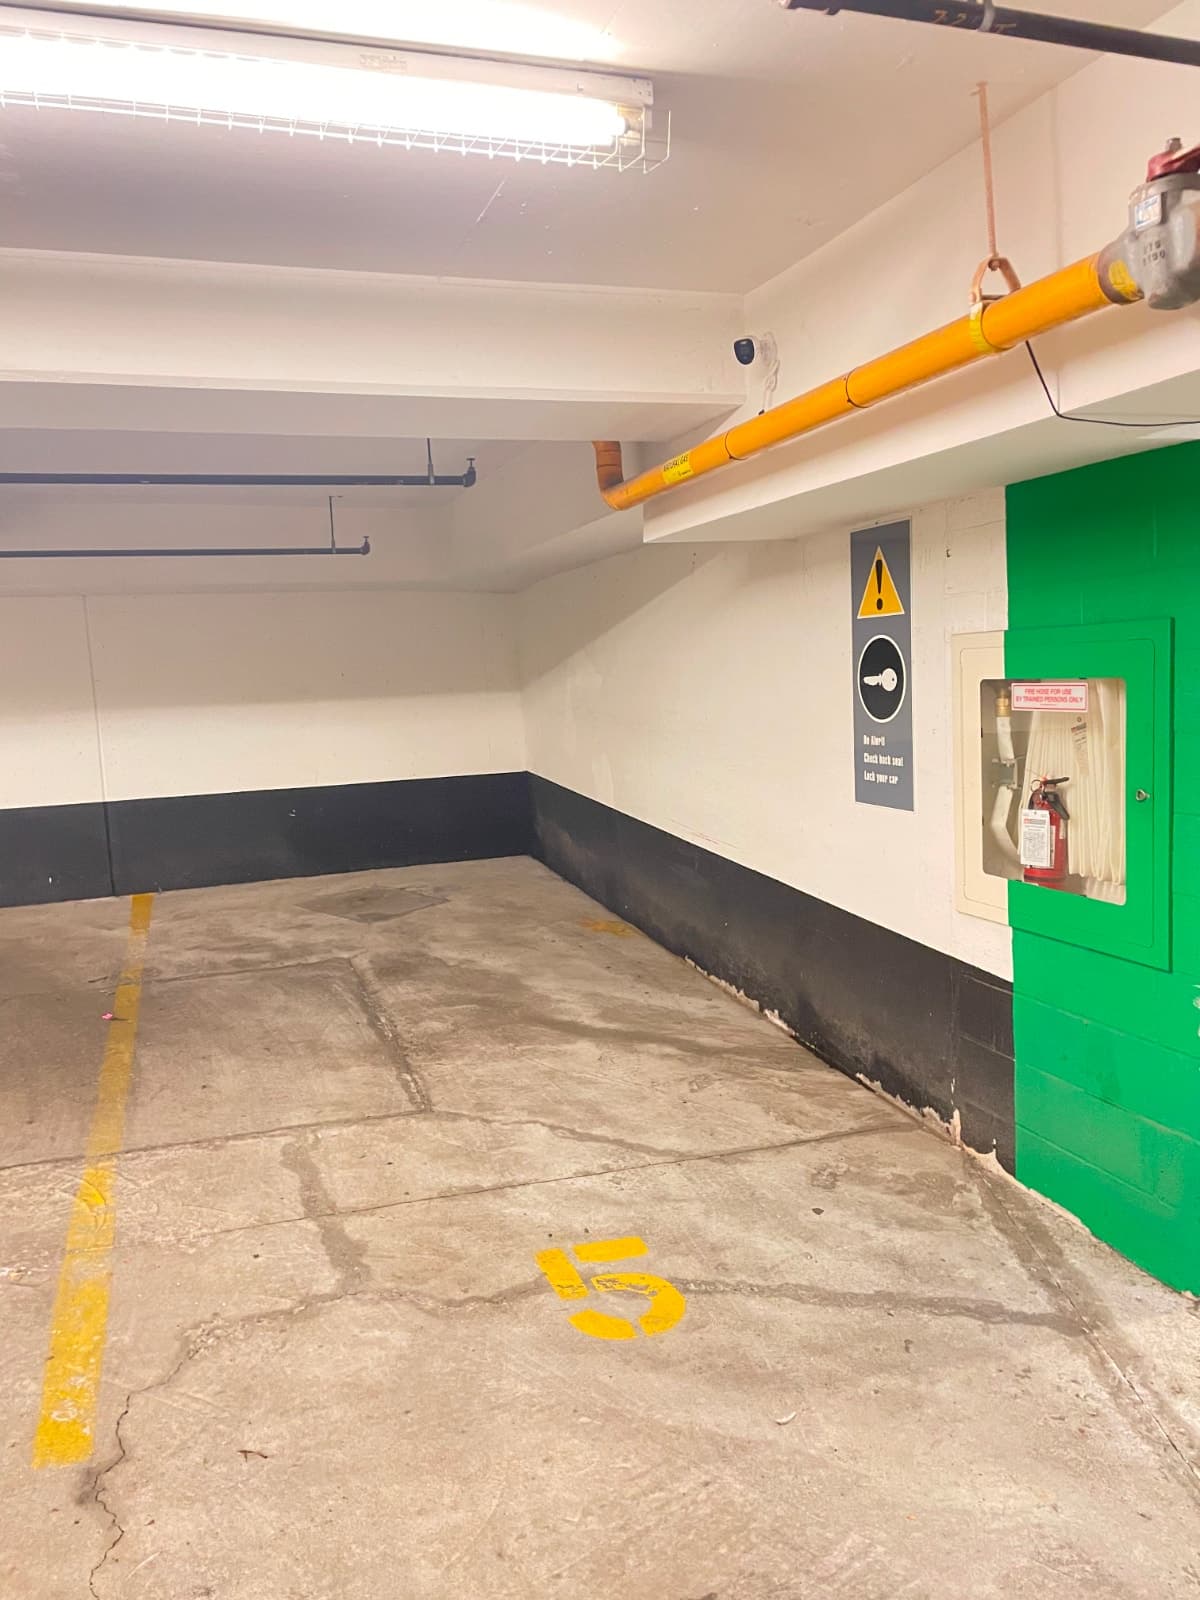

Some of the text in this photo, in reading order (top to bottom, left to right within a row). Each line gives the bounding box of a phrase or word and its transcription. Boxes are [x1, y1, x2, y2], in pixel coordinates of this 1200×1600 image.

[863, 752, 878, 764] Check
[879, 754, 891, 766] back
[863, 769, 899, 785] Lock your car
[535, 1236, 686, 1340] 5
